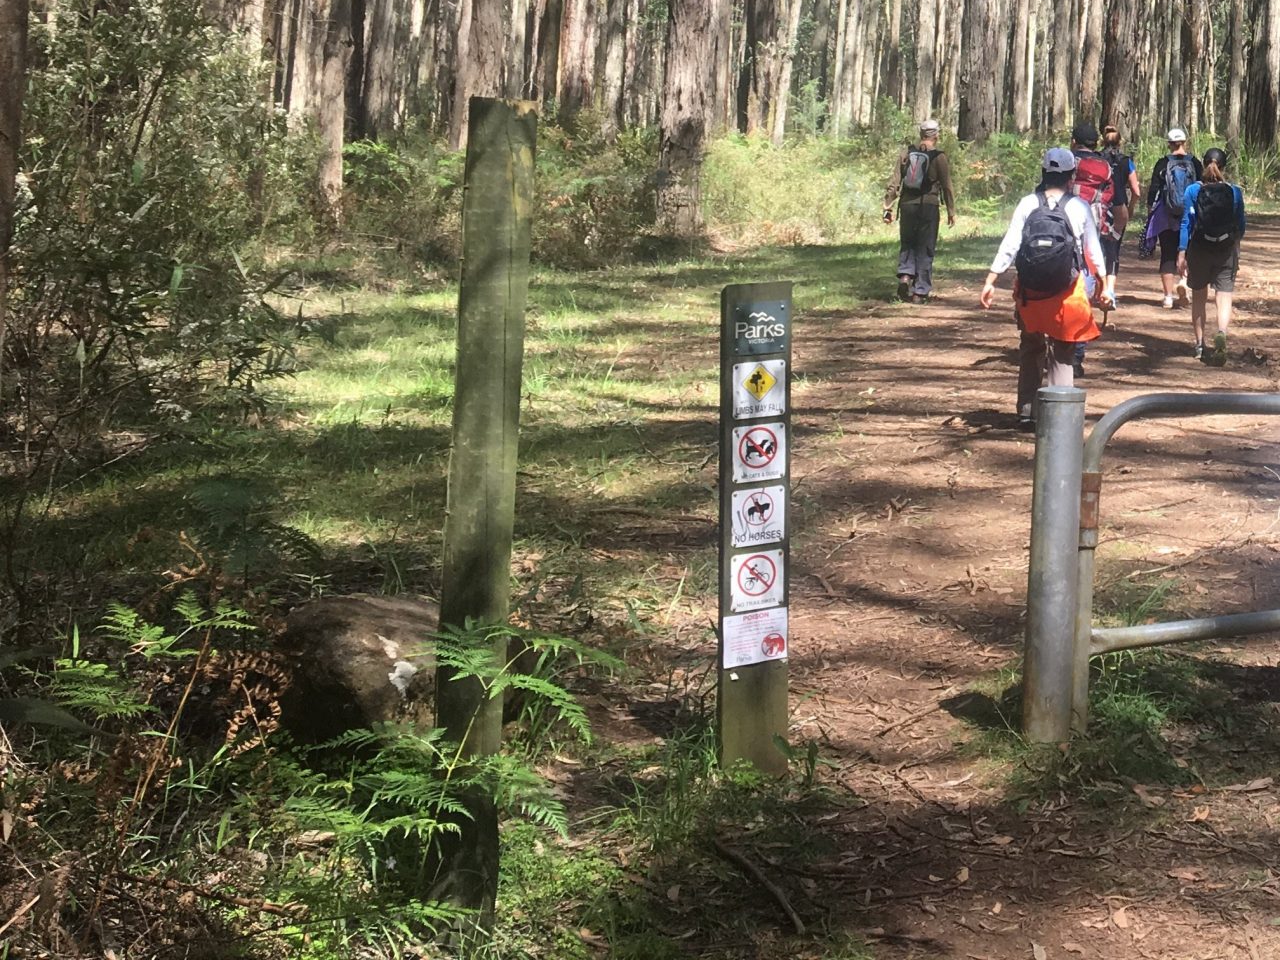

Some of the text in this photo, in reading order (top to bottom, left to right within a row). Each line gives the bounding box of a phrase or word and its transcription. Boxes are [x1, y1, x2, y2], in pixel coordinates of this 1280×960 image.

[735, 322, 785, 339] Parks
[735, 402, 782, 416] LIMBS MAY FALL
[734, 529, 782, 543] NO HORSES
[743, 612, 769, 621] POISON
